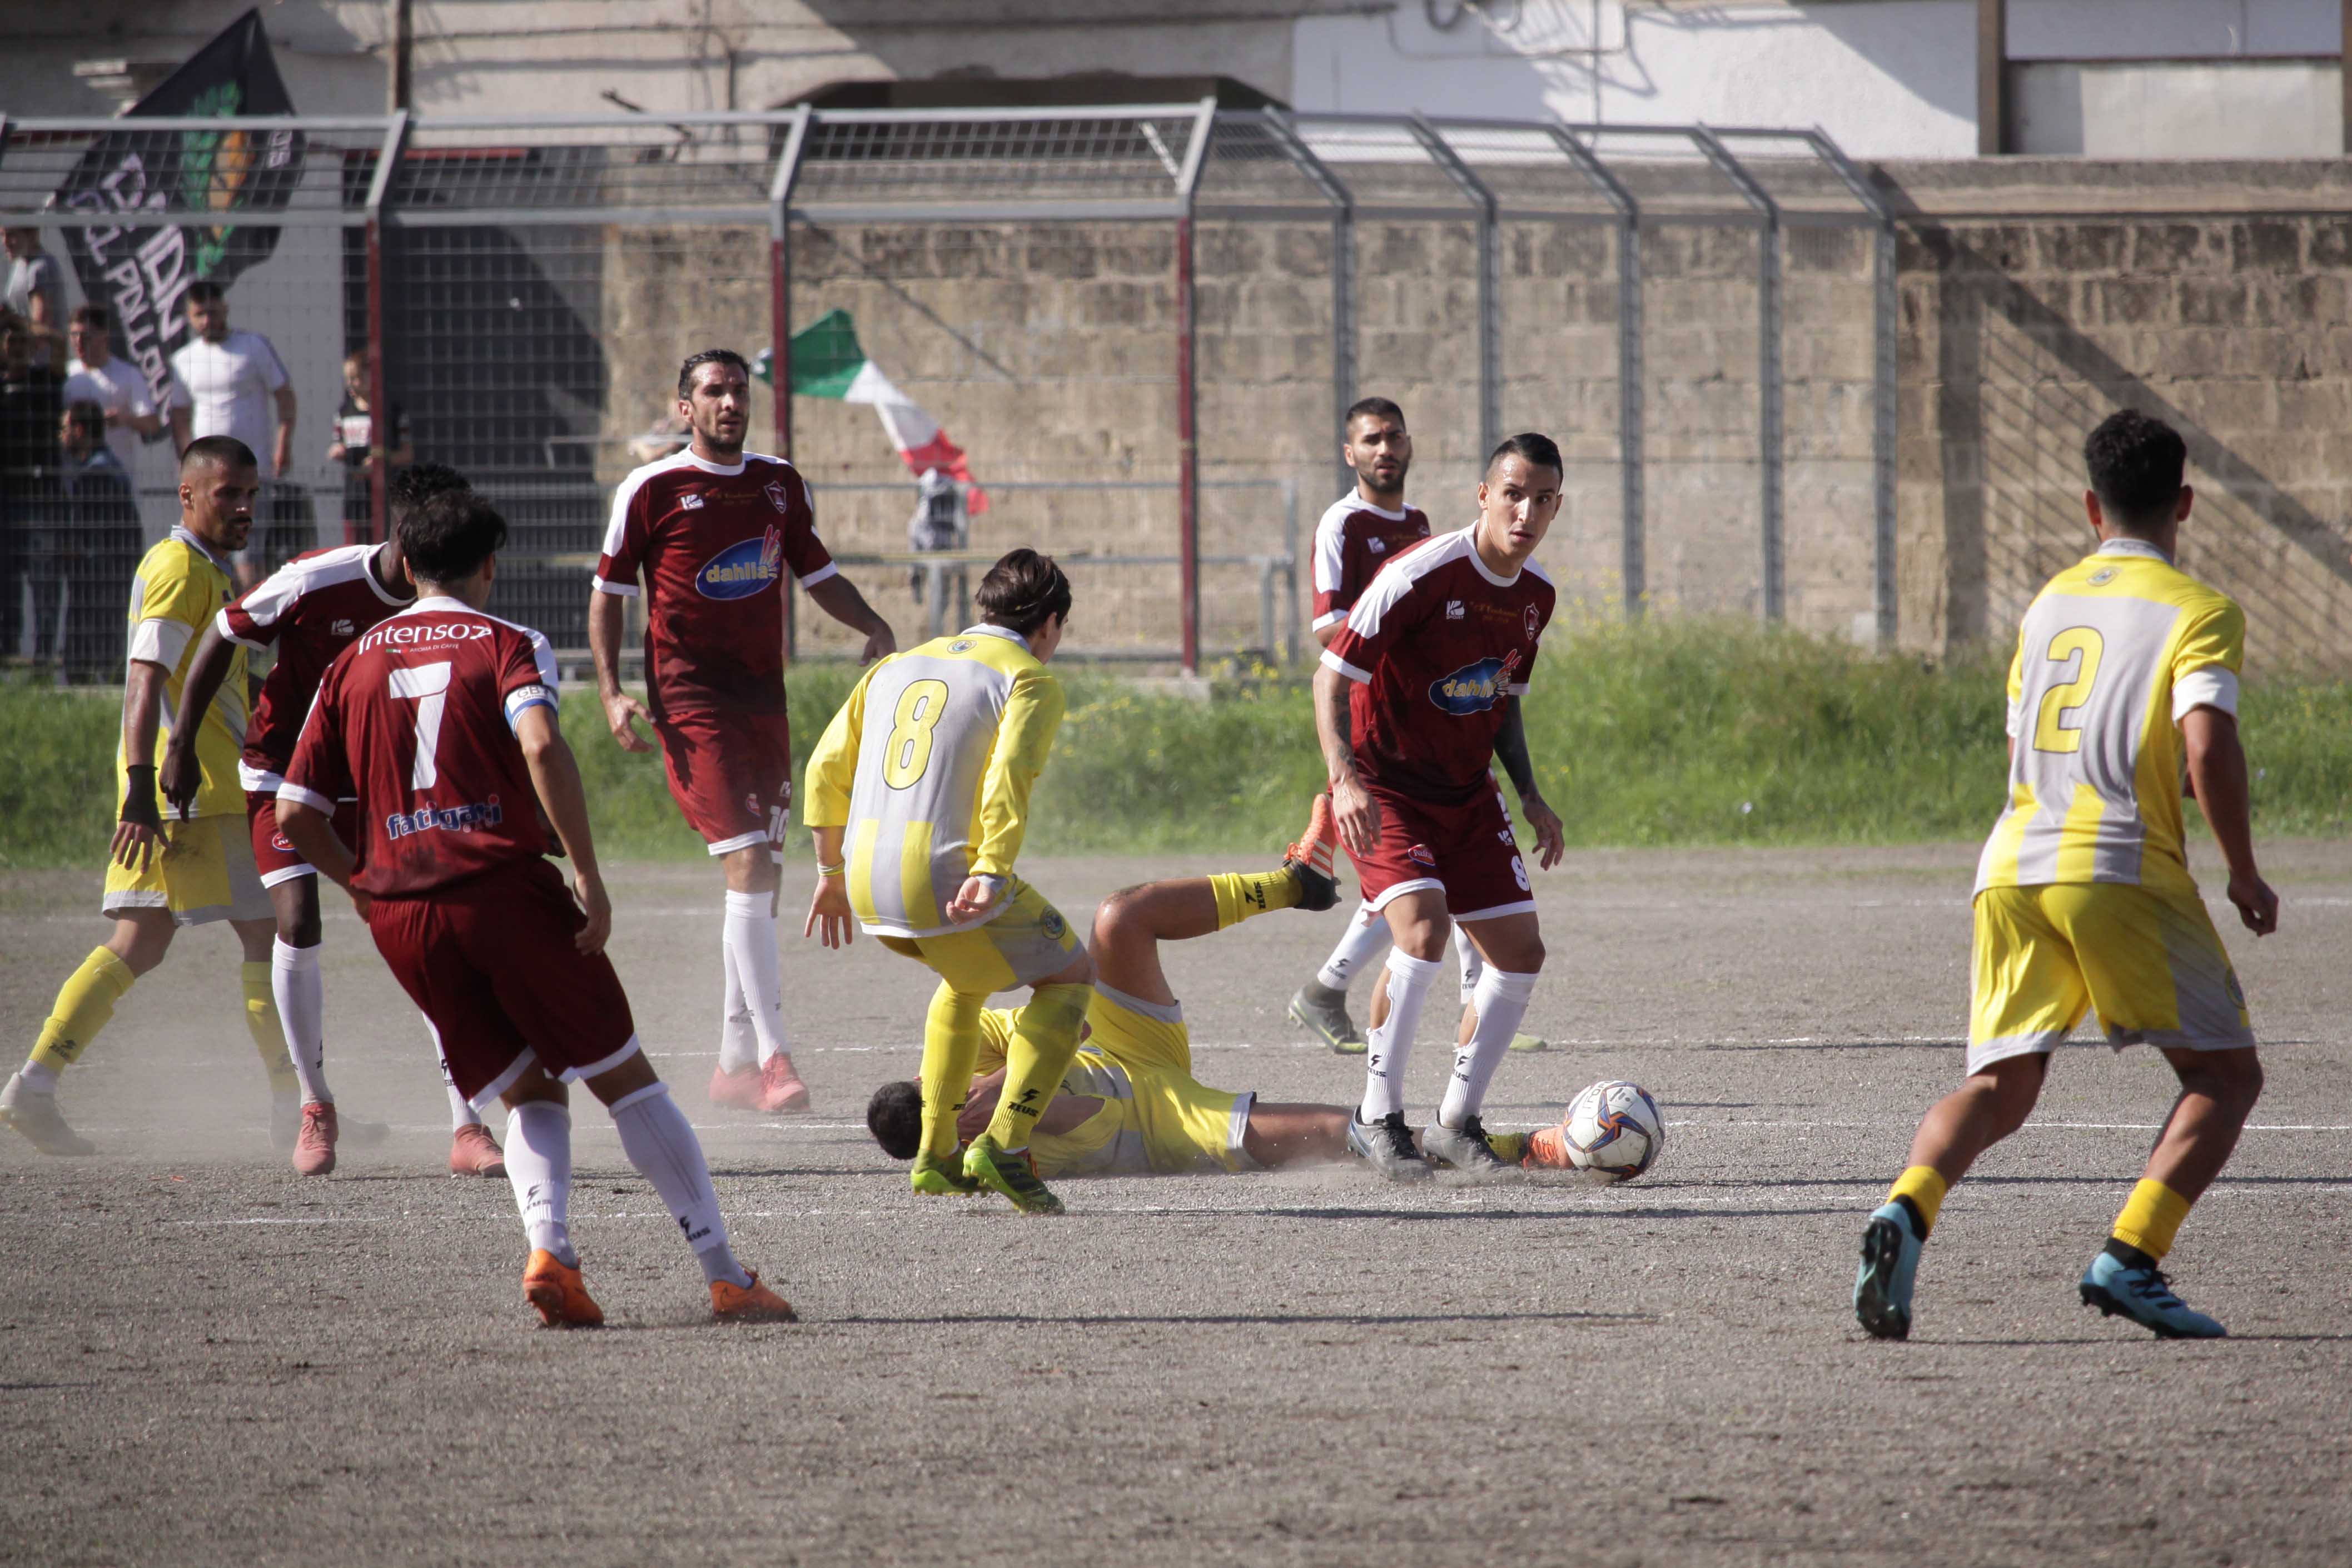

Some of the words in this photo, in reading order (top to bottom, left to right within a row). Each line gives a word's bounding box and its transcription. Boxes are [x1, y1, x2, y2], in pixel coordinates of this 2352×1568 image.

[2033, 625, 2104, 754] 2
[389, 661, 451, 790] 7
[882, 679, 948, 790] 8
[768, 805, 789, 843] 10
[1511, 855, 1530, 892] 8
[1254, 881, 1266, 910] ZEUS
[1008, 1102, 1039, 1117] ZEUS
